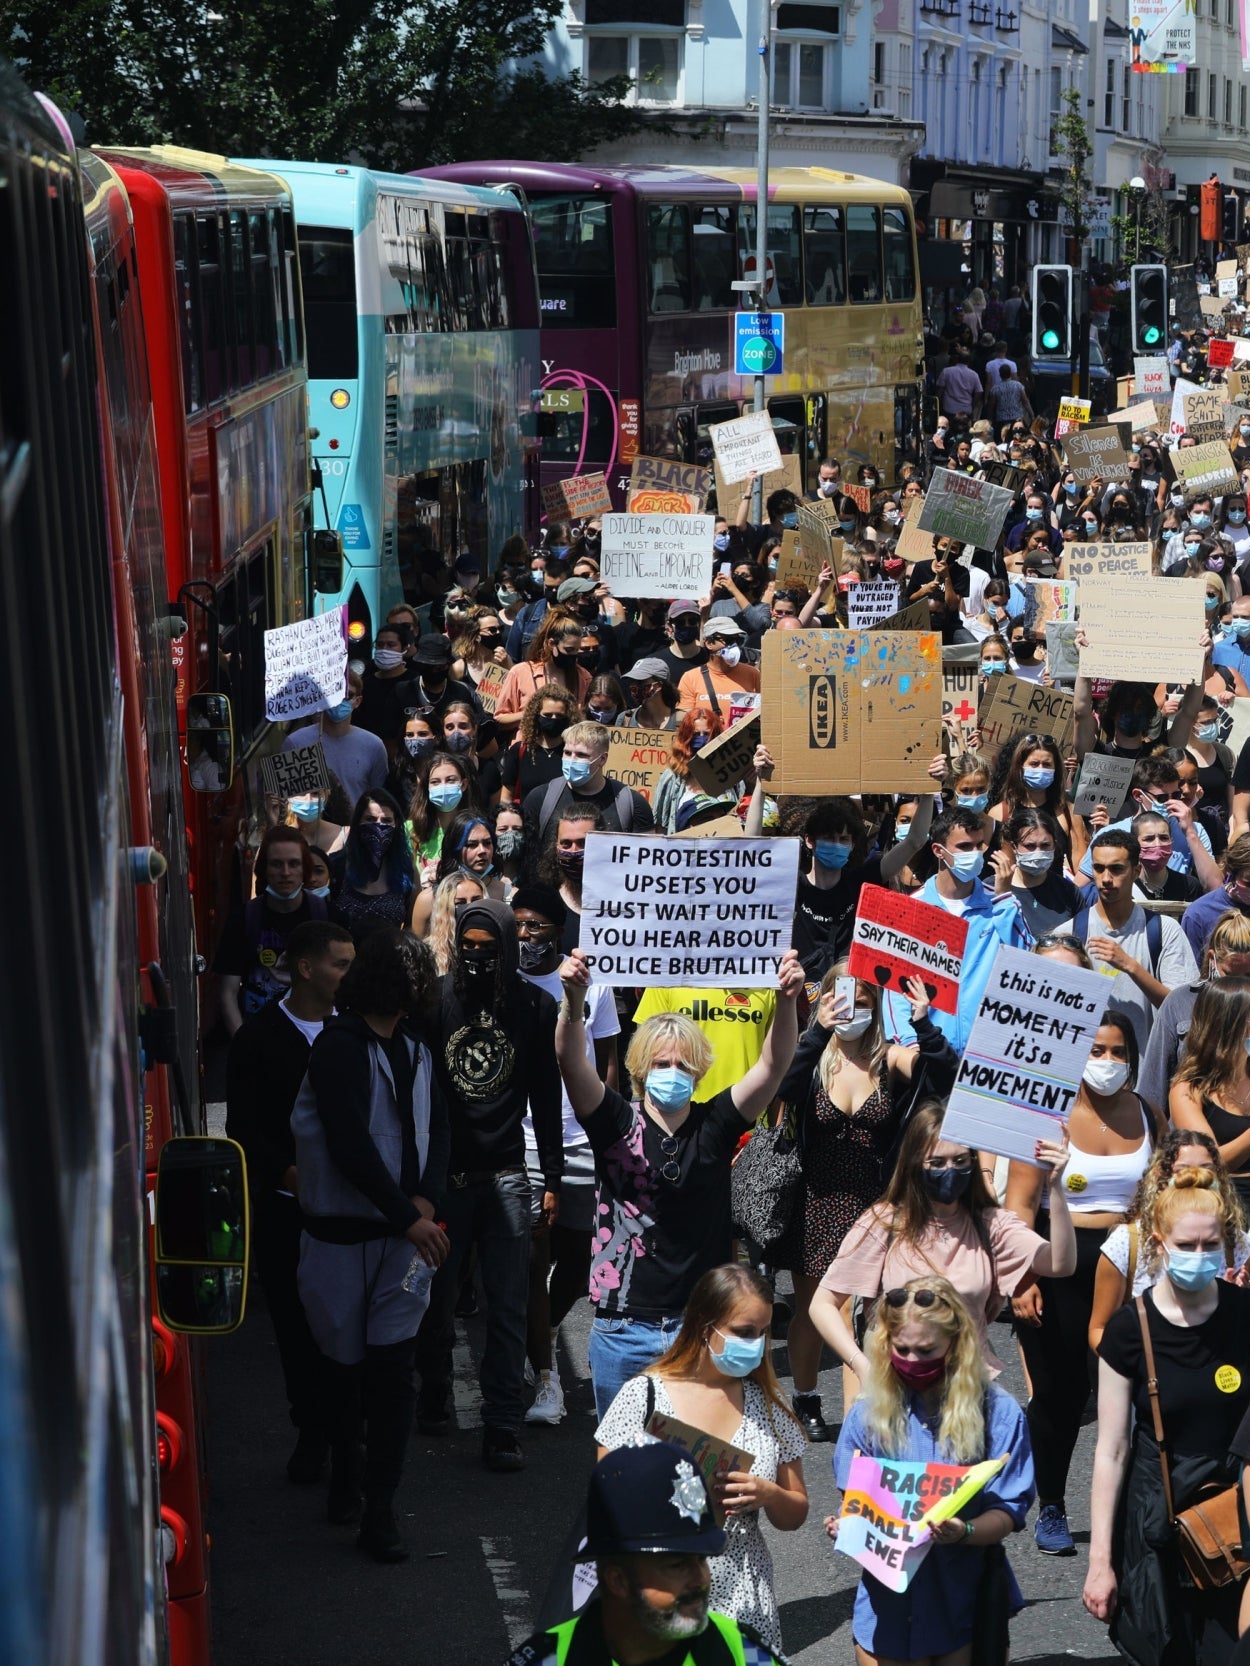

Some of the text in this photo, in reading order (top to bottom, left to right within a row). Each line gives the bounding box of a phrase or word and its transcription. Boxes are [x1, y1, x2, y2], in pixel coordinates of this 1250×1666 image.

[1166, 29, 1191, 38] PROTECT
[739, 326, 780, 336] emission
[750, 316, 769, 326] Low
[674, 348, 721, 374] Brighton Hove
[744, 350, 774, 359] ZONE
[621, 403, 638, 411] thank
[1060, 410, 1086, 421] RACISM
[1061, 404, 1082, 414] NO TO
[620, 422, 638, 431] giving
[1059, 418, 1070, 428] NO
[1069, 433, 1120, 455] Silence
[1089, 454, 1103, 468] IS
[636, 458, 708, 493] BLACK
[1073, 462, 1131, 482] VIOLENCE
[1184, 466, 1234, 488] CHILDREN
[643, 500, 680, 513] BLACK
[609, 517, 706, 536] DIVIDE AND CONQUER
[622, 541, 685, 550] MUST BECOME
[1070, 543, 1149, 560] NO JUSTICE
[1069, 558, 1139, 575] NO PEACE
[849, 582, 858, 592] IF
[860, 582, 883, 592] YOU'RE
[856, 592, 894, 602] OUTRAGED
[850, 604, 893, 613] YOU'RE NOT
[817, 682, 828, 739] IKEA
[1011, 712, 1039, 729] THE
[271, 745, 317, 771] BLACK
[276, 760, 319, 783] LIVES
[1088, 777, 1127, 791] NO JUSTICE
[1083, 793, 1117, 806] NO PEACE
[611, 845, 773, 868] IF PROTESTING
[624, 874, 757, 895] UPSETS YOU
[595, 899, 779, 921] JUST WAIT UNTIL
[590, 927, 782, 949] YOU HEAR ABOUT
[858, 922, 963, 979] SAY THEIR NAMES
[584, 956, 783, 976] POLICE BRUTALITY
[999, 969, 1098, 1014] this is not a
[679, 999, 763, 1025] ellesse
[978, 996, 1087, 1045] MOMENT
[957, 1058, 1078, 1113] MOVEMENT
[879, 1465, 971, 1498] RACISM
[844, 1498, 915, 1543] SMALL
[901, 1499, 928, 1522] IS
[864, 1530, 903, 1569] EWE
